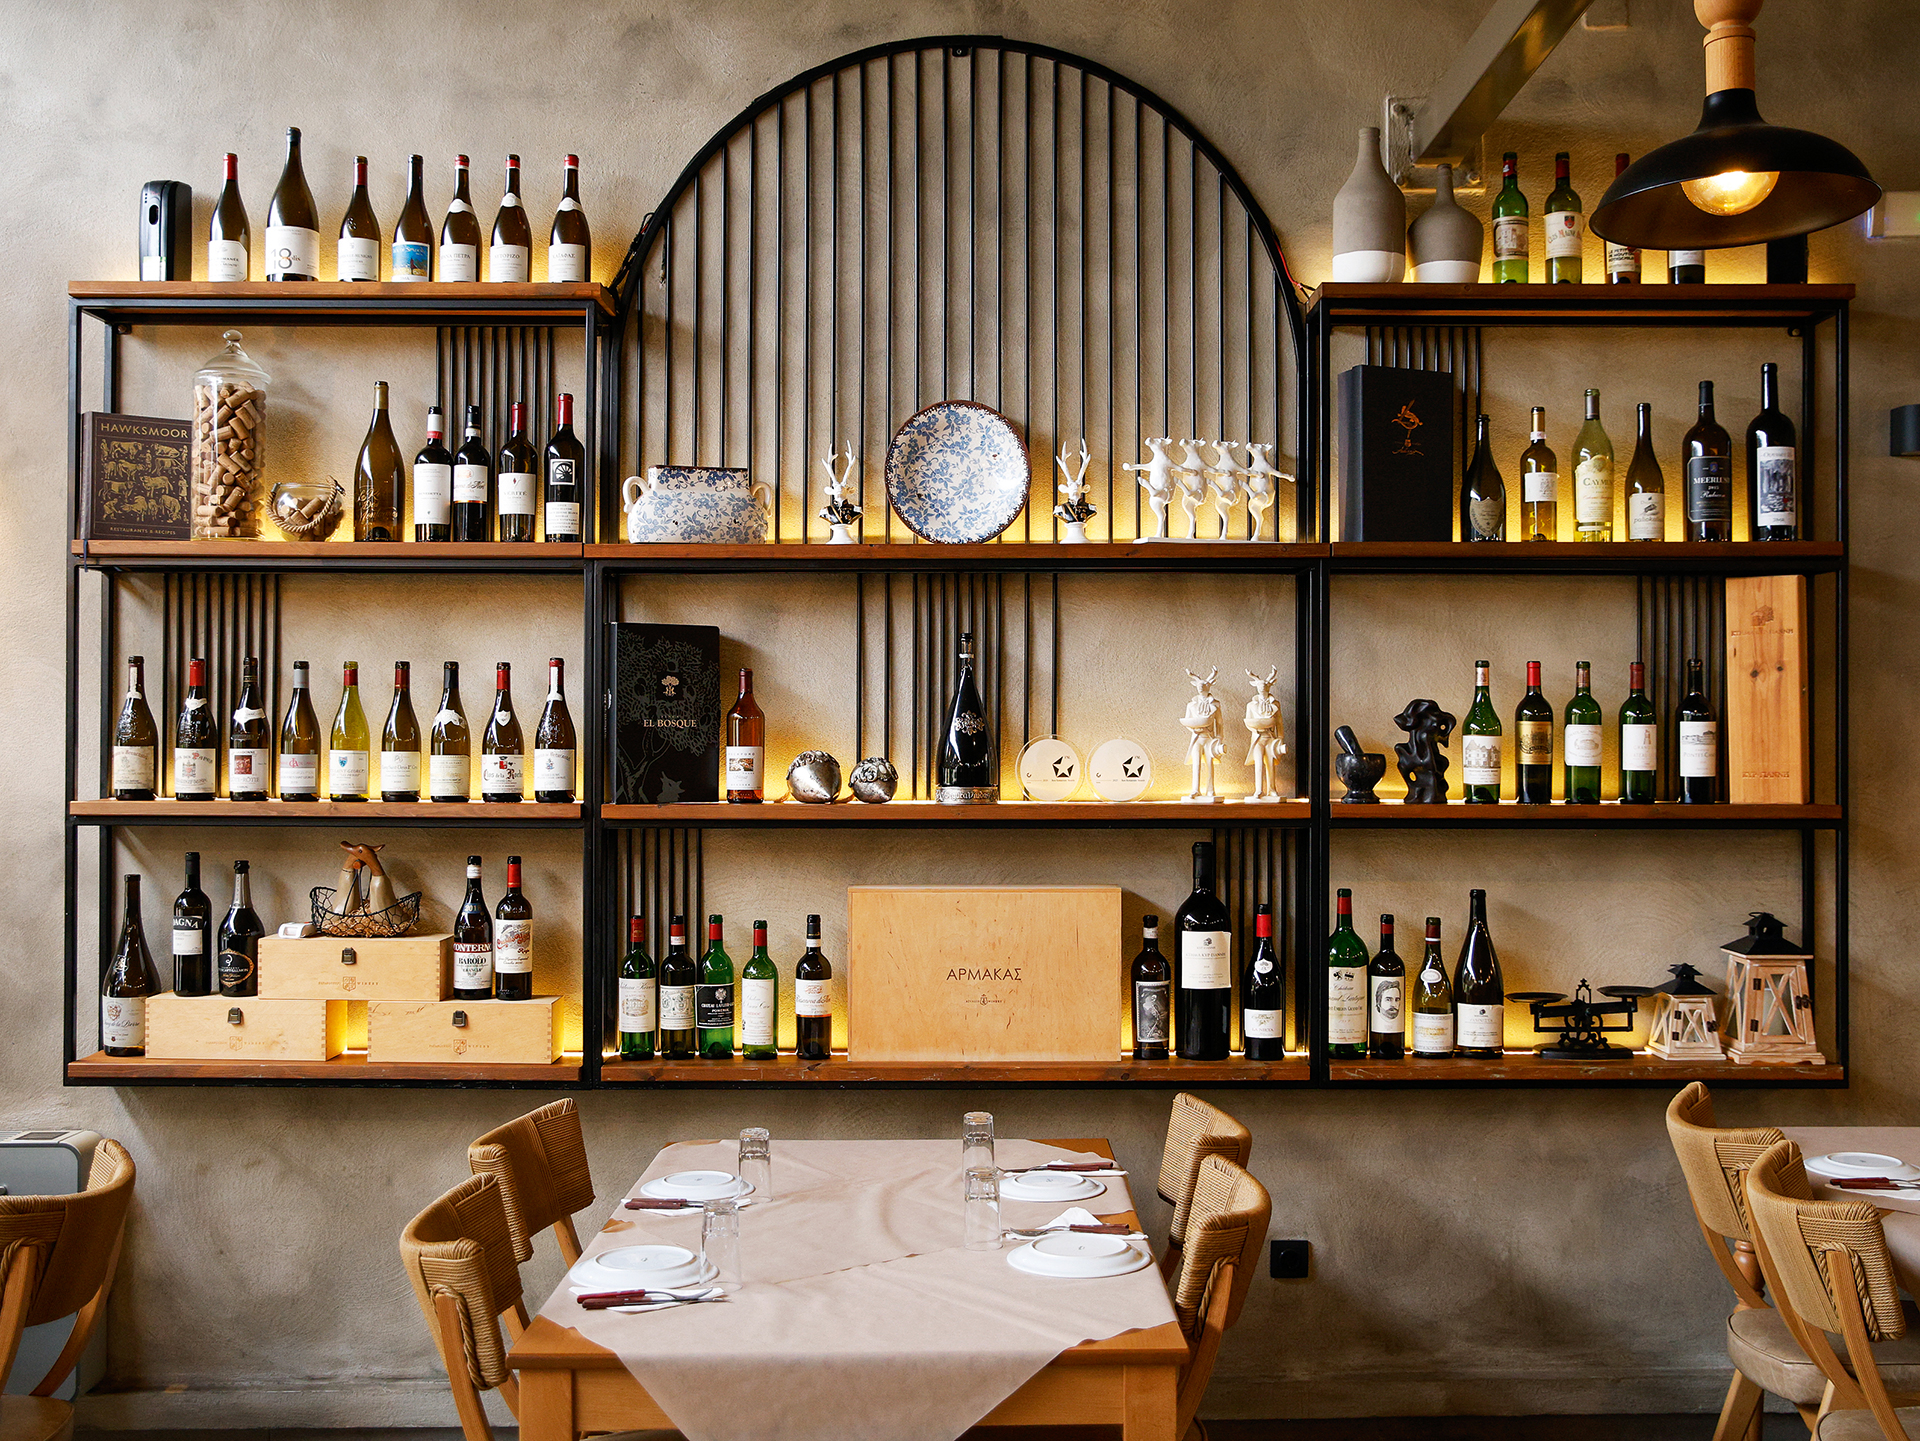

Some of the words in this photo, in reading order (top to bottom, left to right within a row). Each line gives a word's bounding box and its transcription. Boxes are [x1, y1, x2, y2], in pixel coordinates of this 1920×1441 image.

[101, 422, 188, 439] HAWKSMOOR
[110, 526, 148, 534] RESTAURANTS
[643, 719, 655, 728] EL
[657, 719, 697, 729] BOSQUE
[946, 968, 1022, 981] ΑΡΜΑΚΑΣ
